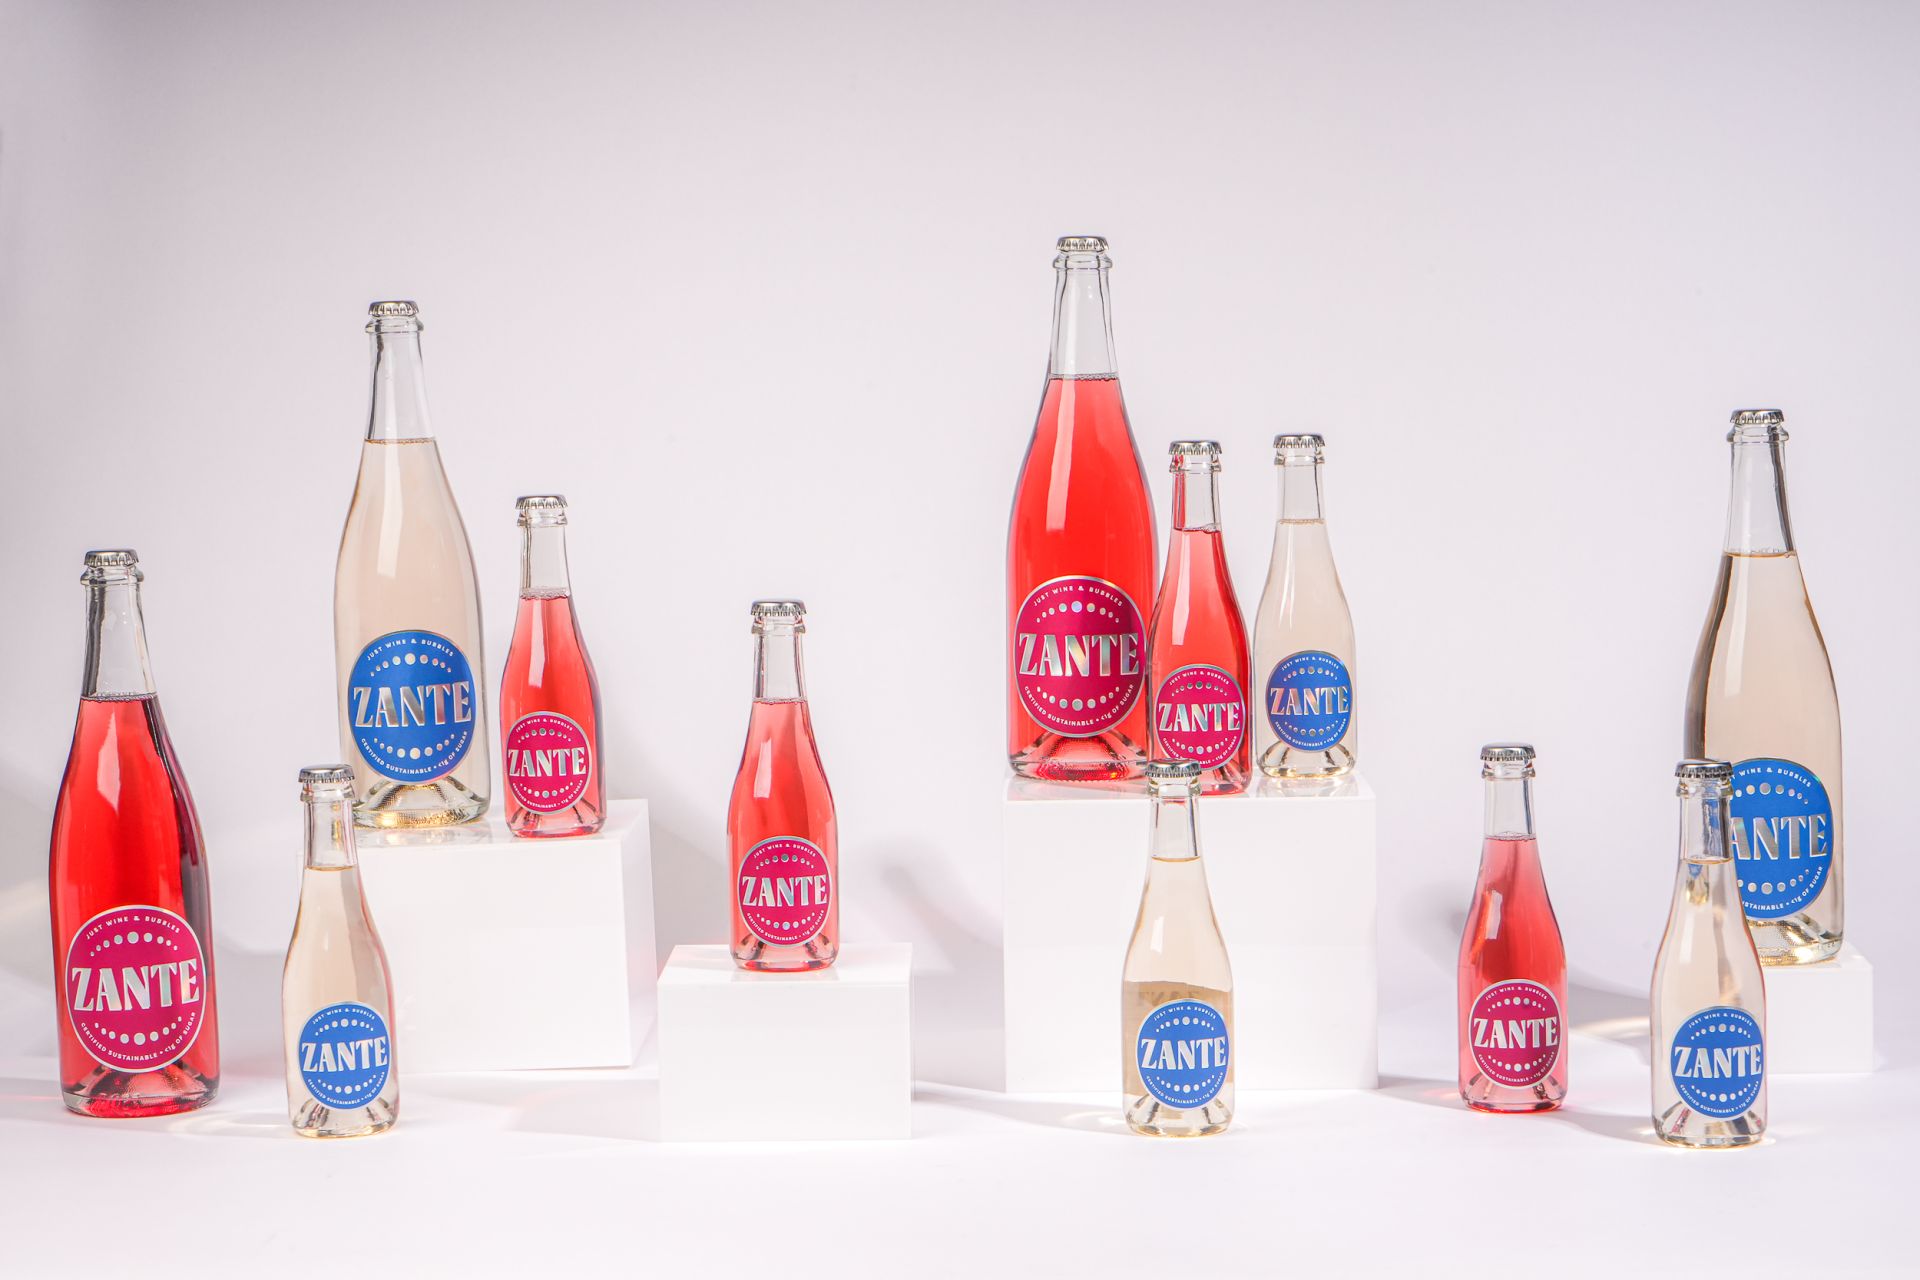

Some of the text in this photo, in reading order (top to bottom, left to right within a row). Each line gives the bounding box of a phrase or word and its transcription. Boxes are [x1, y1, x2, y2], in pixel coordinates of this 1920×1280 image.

[1033, 592, 1050, 607] JUST
[1052, 586, 1074, 595] WINE
[1089, 587, 1123, 607] BUBBLES
[367, 646, 383, 660] JUST
[385, 639, 407, 649] WINE
[421, 639, 454, 657] BUBBLES
[1019, 633, 1139, 677] ZANTE
[1281, 661, 1293, 671] JUST
[1319, 657, 1339, 669] BUBBLES
[1169, 675, 1181, 686] JUST
[1207, 671, 1229, 685] BUBBLES
[353, 681, 472, 728] ZANTE
[1024, 686, 1047, 715] CERTIFIED
[1047, 713, 1094, 726] SUSTAINABLE
[1112, 706, 1121, 714] OF
[1120, 684, 1134, 706] SUGAR
[1270, 685, 1349, 715] ZANTE
[515, 723, 526, 732] JUST
[550, 719, 573, 731] BUBBLES
[1158, 701, 1240, 732] ZANTE
[361, 738, 385, 765] CERTIFIED
[386, 763, 432, 774] SUSTAINABLE
[448, 751, 456, 760] OF
[455, 731, 468, 752] SUGAR
[508, 747, 586, 777] ZANTE
[1738, 767, 1762, 777] WINE
[1777, 768, 1812, 787] BUBBLES
[753, 848, 765, 859] JUST
[793, 844, 816, 857] BUBBLES
[1730, 813, 1827, 861] ANTE
[742, 874, 827, 907] ZANTE
[1741, 900, 1784, 911] STAINABLE
[1802, 888, 1810, 897] OF
[1809, 866, 1823, 889] SUGAR
[86, 924, 104, 940] JUST
[106, 915, 129, 927] WINE
[145, 915, 181, 934] BUBBLES
[71, 958, 200, 1012] ZANTE
[1485, 991, 1497, 1000] JUST
[1525, 987, 1548, 1000] BUBBLES
[312, 1014, 325, 1025] JUST
[352, 1008, 375, 1020] BUBBLES
[1154, 1011, 1166, 1021] JUST
[1194, 1006, 1216, 1019] BUBBLES
[1688, 1018, 1702, 1029] JUST
[1730, 1013, 1752, 1026] BUBBLES
[81, 1022, 107, 1053] CERTIFIED
[108, 1050, 158, 1061] SUSTAINABLE
[175, 1035, 184, 1045] OF
[183, 1012, 196, 1035] SUGAR
[1473, 1016, 1558, 1049] ZANTE
[301, 1036, 388, 1072] ZANTE
[1141, 1036, 1226, 1070] ZANTE
[1674, 1044, 1762, 1079] ZANTE
